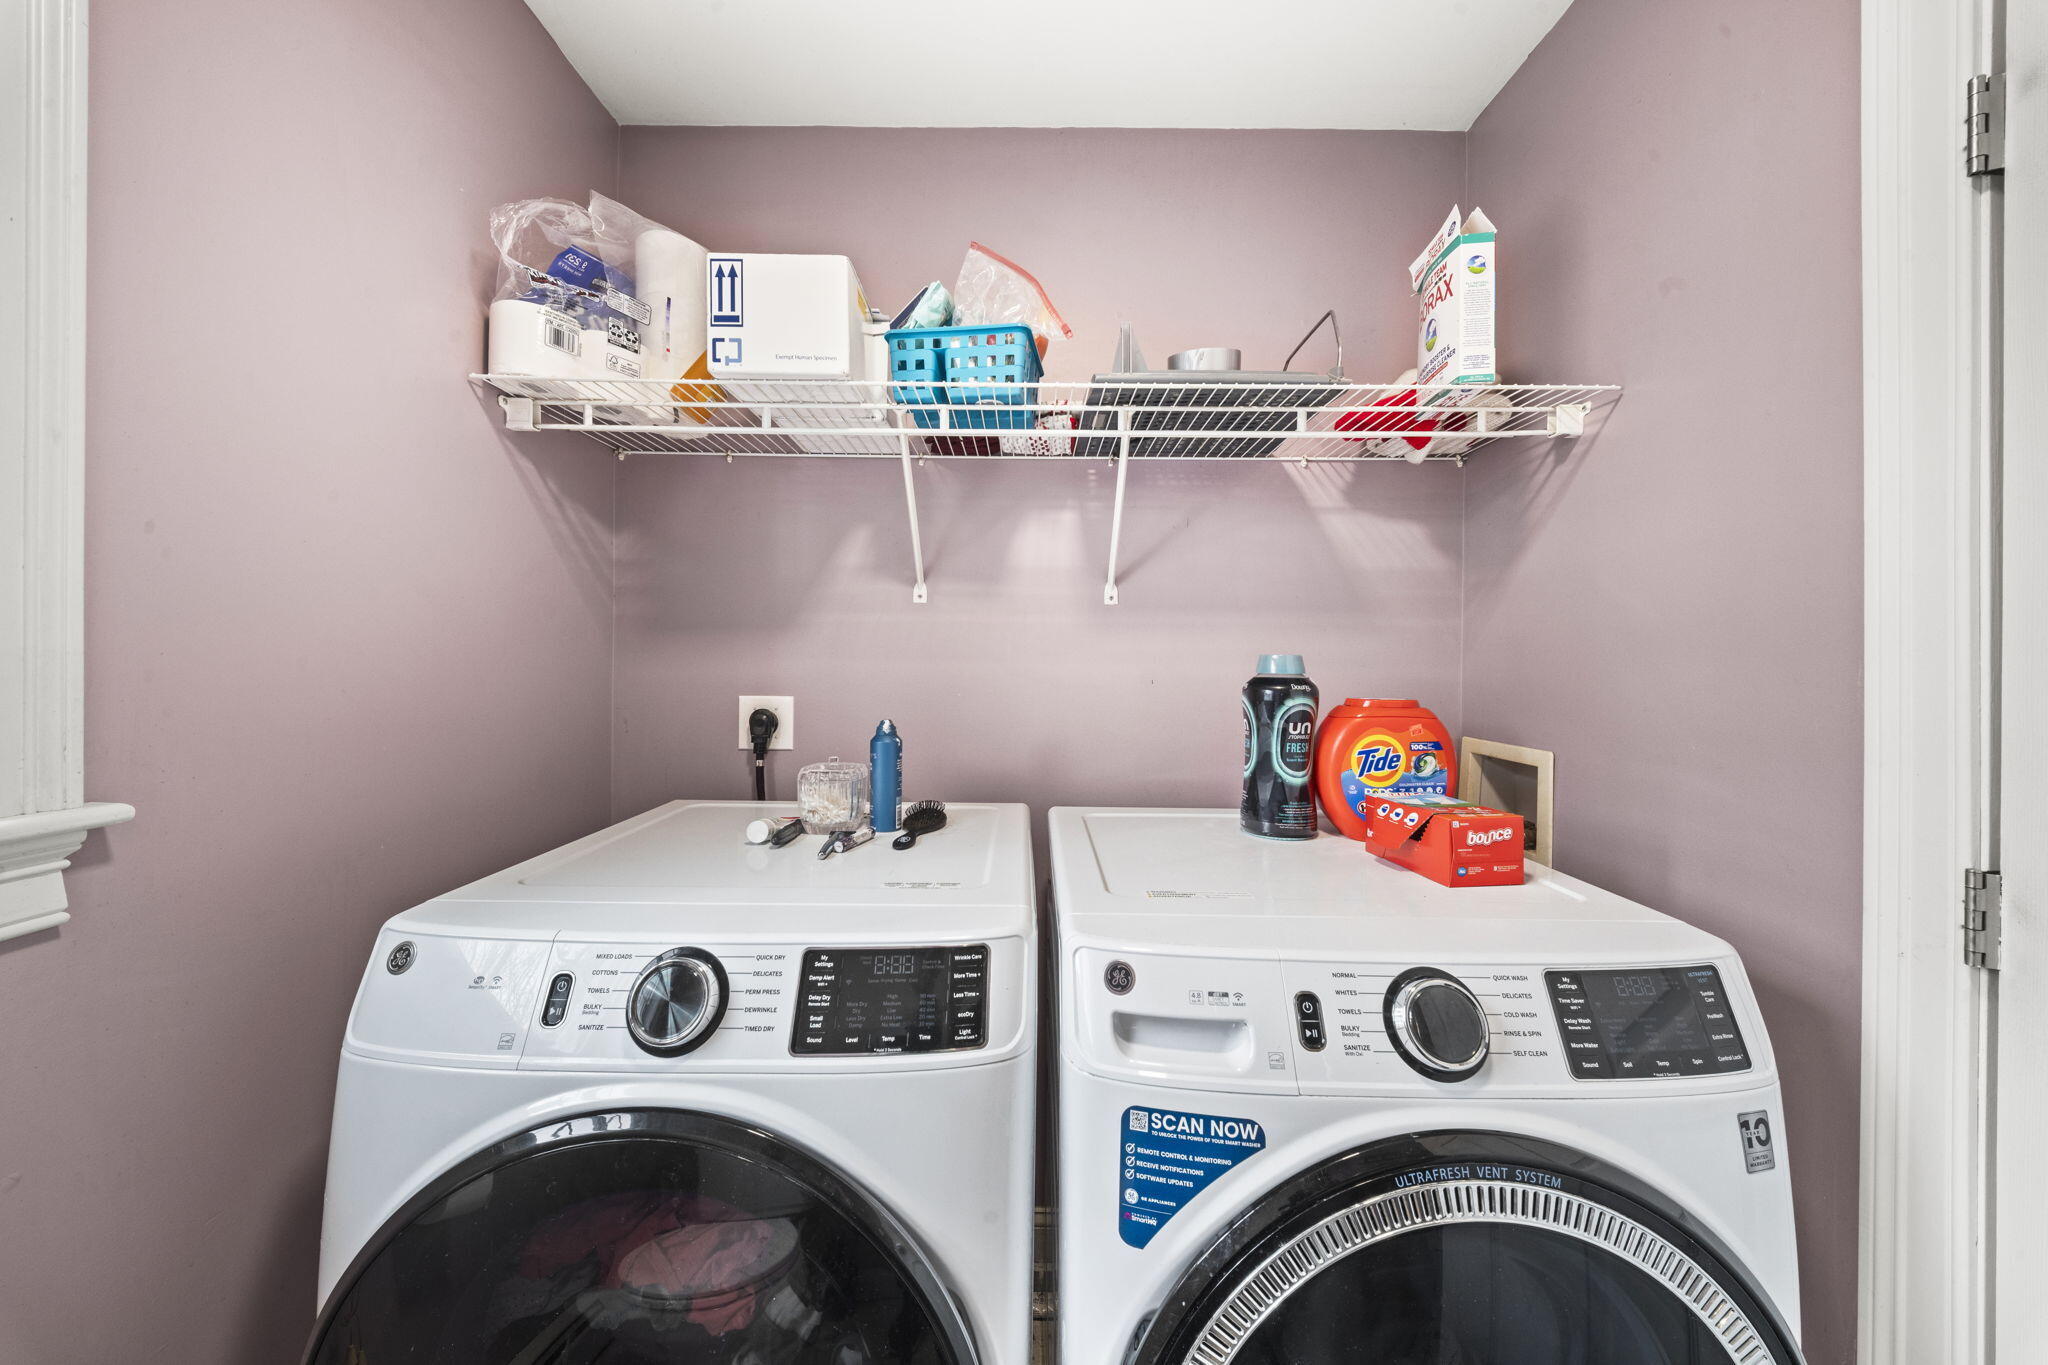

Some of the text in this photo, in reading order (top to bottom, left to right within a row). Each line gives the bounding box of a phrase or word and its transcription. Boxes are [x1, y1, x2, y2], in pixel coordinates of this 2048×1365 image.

[775, 353, 793, 361] Exempt
[1291, 683, 1311, 692] Downy
[1357, 747, 1402, 778] Tide
[1466, 827, 1514, 847] bounce
[1151, 1112, 1258, 1140] SCAN NOW
[1740, 1118, 1770, 1148] 10
[1137, 1147, 1159, 1156] REMOTE
[1161, 1151, 1188, 1160] CONTROL
[1195, 1156, 1231, 1165] MONITORING
[1137, 1161, 1204, 1176] RECEIVE NOTIFICATIONS
[1395, 1166, 1562, 1189] ULTRAFRESH VENT SYSTEM
[1136, 1173, 1193, 1188] SOFTWARE UPDATES
[1148, 1198, 1176, 1206] APPLIANCES
